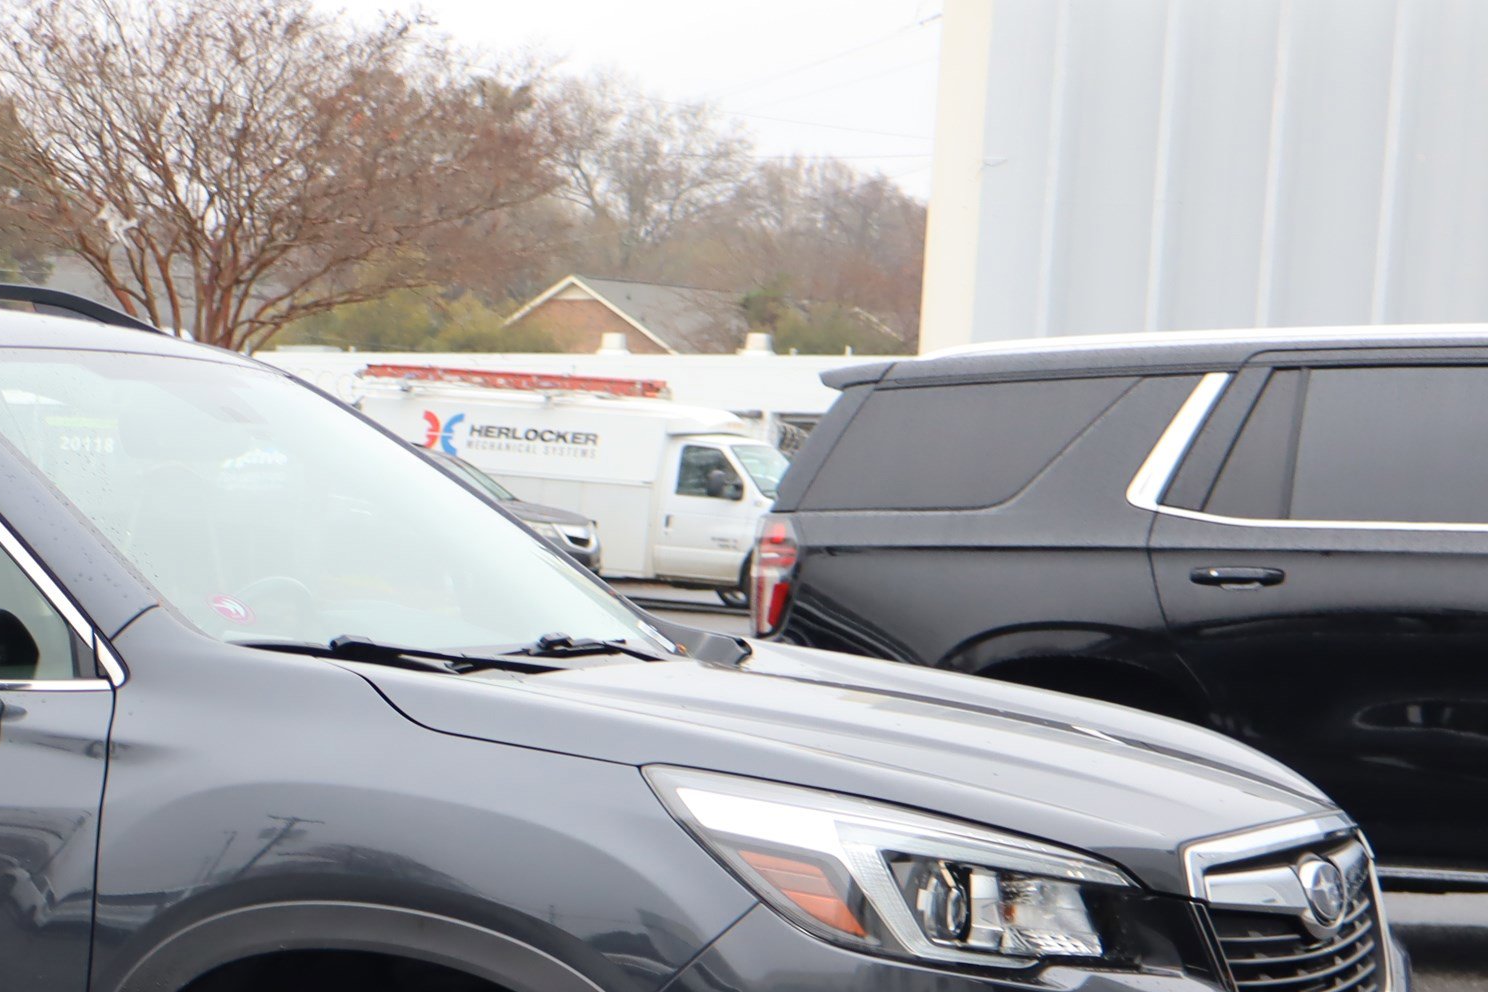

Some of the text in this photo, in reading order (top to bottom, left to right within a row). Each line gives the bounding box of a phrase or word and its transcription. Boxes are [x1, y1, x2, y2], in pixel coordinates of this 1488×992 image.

[469, 424, 599, 446] HERLOCKER
[466, 440, 597, 459] MECHANICAL SYSTEMS
